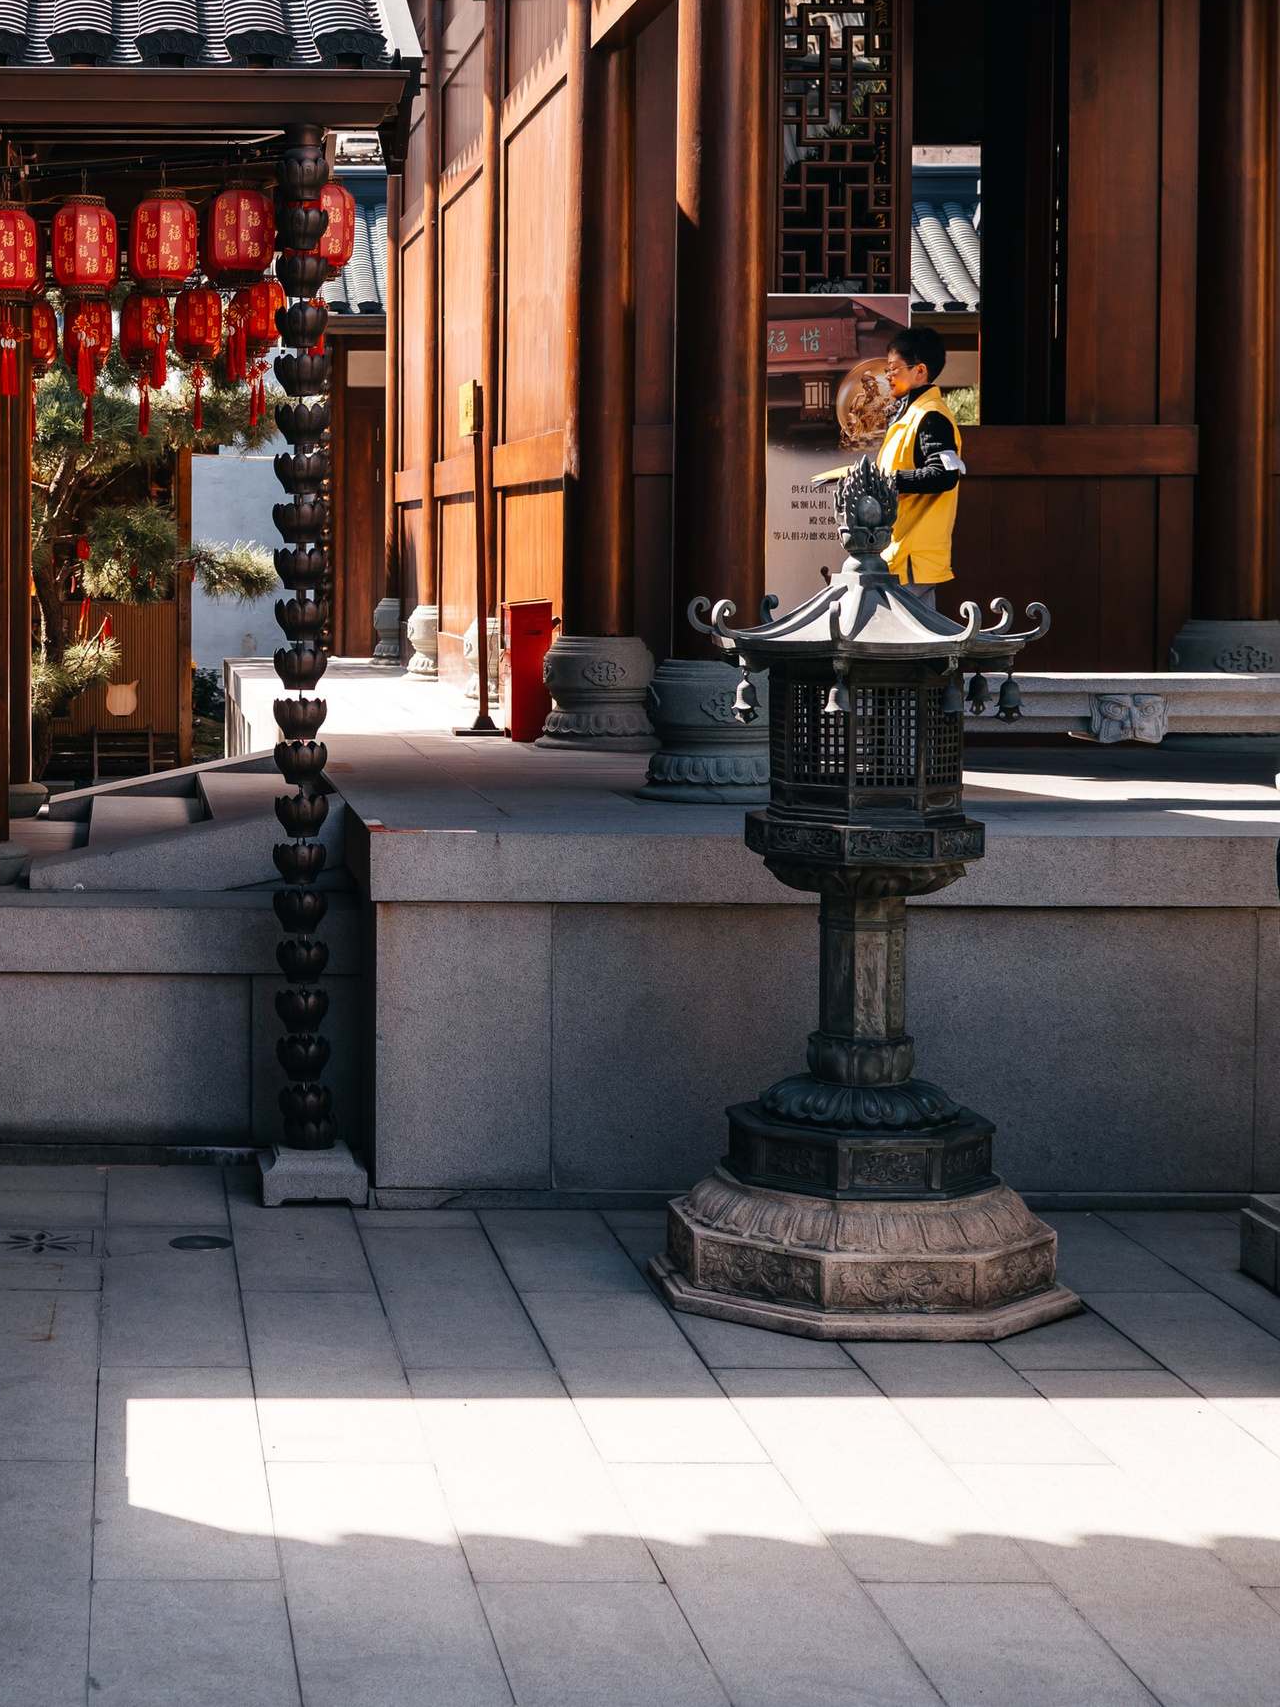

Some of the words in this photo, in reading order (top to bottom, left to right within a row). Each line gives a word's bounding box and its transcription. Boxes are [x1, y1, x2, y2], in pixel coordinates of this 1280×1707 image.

[218, 199, 227, 210] 福
[240, 199, 250, 210] 福
[322, 195, 332, 207] 福
[58, 215, 66, 227] 福
[79, 215, 88, 227] 福
[101, 215, 107, 226] 福
[140, 211, 149, 223] 福
[162, 212, 172, 223] 福
[184, 210, 190, 221] 福
[225, 210, 236, 226] 福
[247, 211, 260, 227] 福
[329, 207, 341, 223] 福
[17, 219, 25, 231] 福
[146, 223, 157, 239] 福
[188, 223, 195, 239] 福
[63, 227, 73, 243] 福
[85, 227, 98, 243] 福
[106, 228, 113, 243] 福
[168, 224, 181, 240] 福
[218, 229, 227, 241] 福
[240, 230, 250, 241] 福
[1, 231, 14, 247] 福
[24, 232, 33, 247] 福
[58, 246, 66, 258] 福
[79, 245, 88, 257] 福
[102, 246, 108, 257] 福
[140, 242, 148, 254] 福
[161, 242, 170, 254] 福
[185, 241, 190, 252] 福
[225, 241, 237, 256] 福
[248, 242, 260, 258] 福
[328, 239, 341, 254] 福
[20, 251, 27, 261] 福
[146, 254, 157, 269] 福
[188, 254, 194, 270] 福
[64, 258, 74, 273] 福
[85, 258, 98, 274] 福
[105, 258, 113, 274] 福
[167, 255, 179, 271] 福
[2, 262, 15, 278] 福
[25, 262, 34, 278] 福
[257, 297, 266, 308] 福
[39, 317, 47, 328] 福
[91, 313, 100, 324] 福
[257, 319, 266, 330] 福
[39, 338, 47, 349] 福
